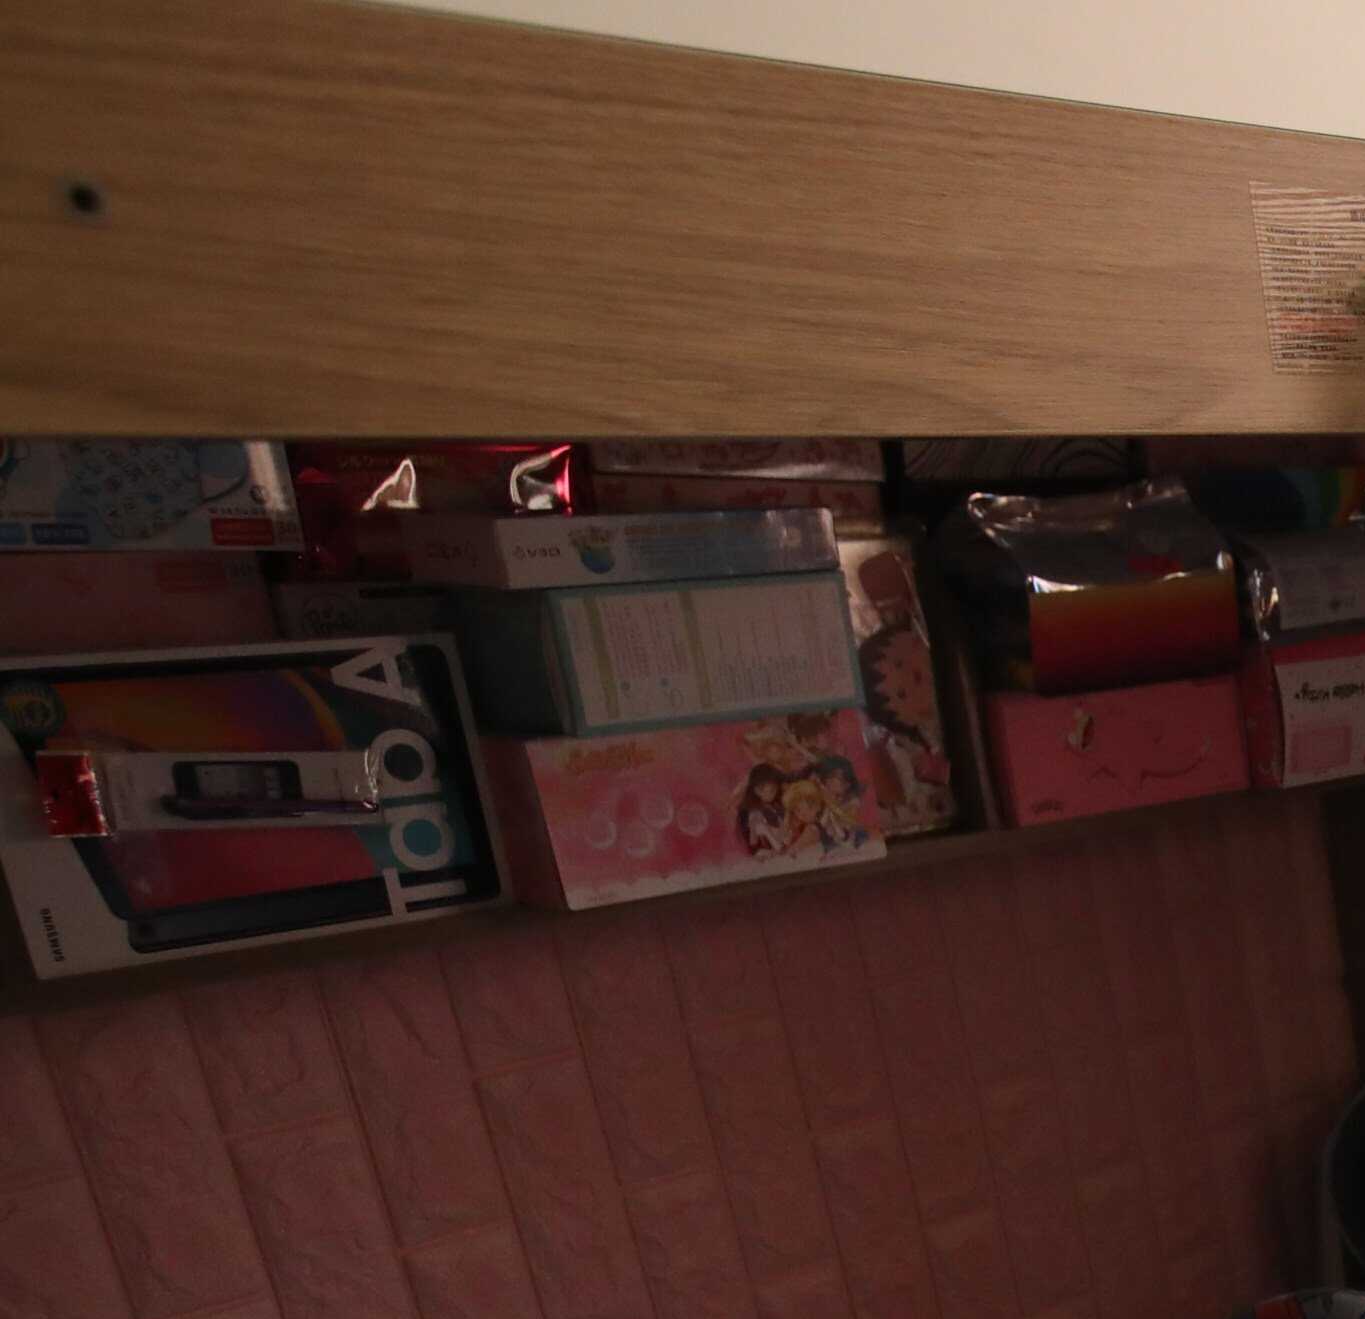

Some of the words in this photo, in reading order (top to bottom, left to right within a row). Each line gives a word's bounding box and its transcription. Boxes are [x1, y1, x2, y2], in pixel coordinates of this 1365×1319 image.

[329, 640, 423, 707] A
[364, 728, 467, 920] Tab
[40, 908, 65, 962] SAMSUNG
